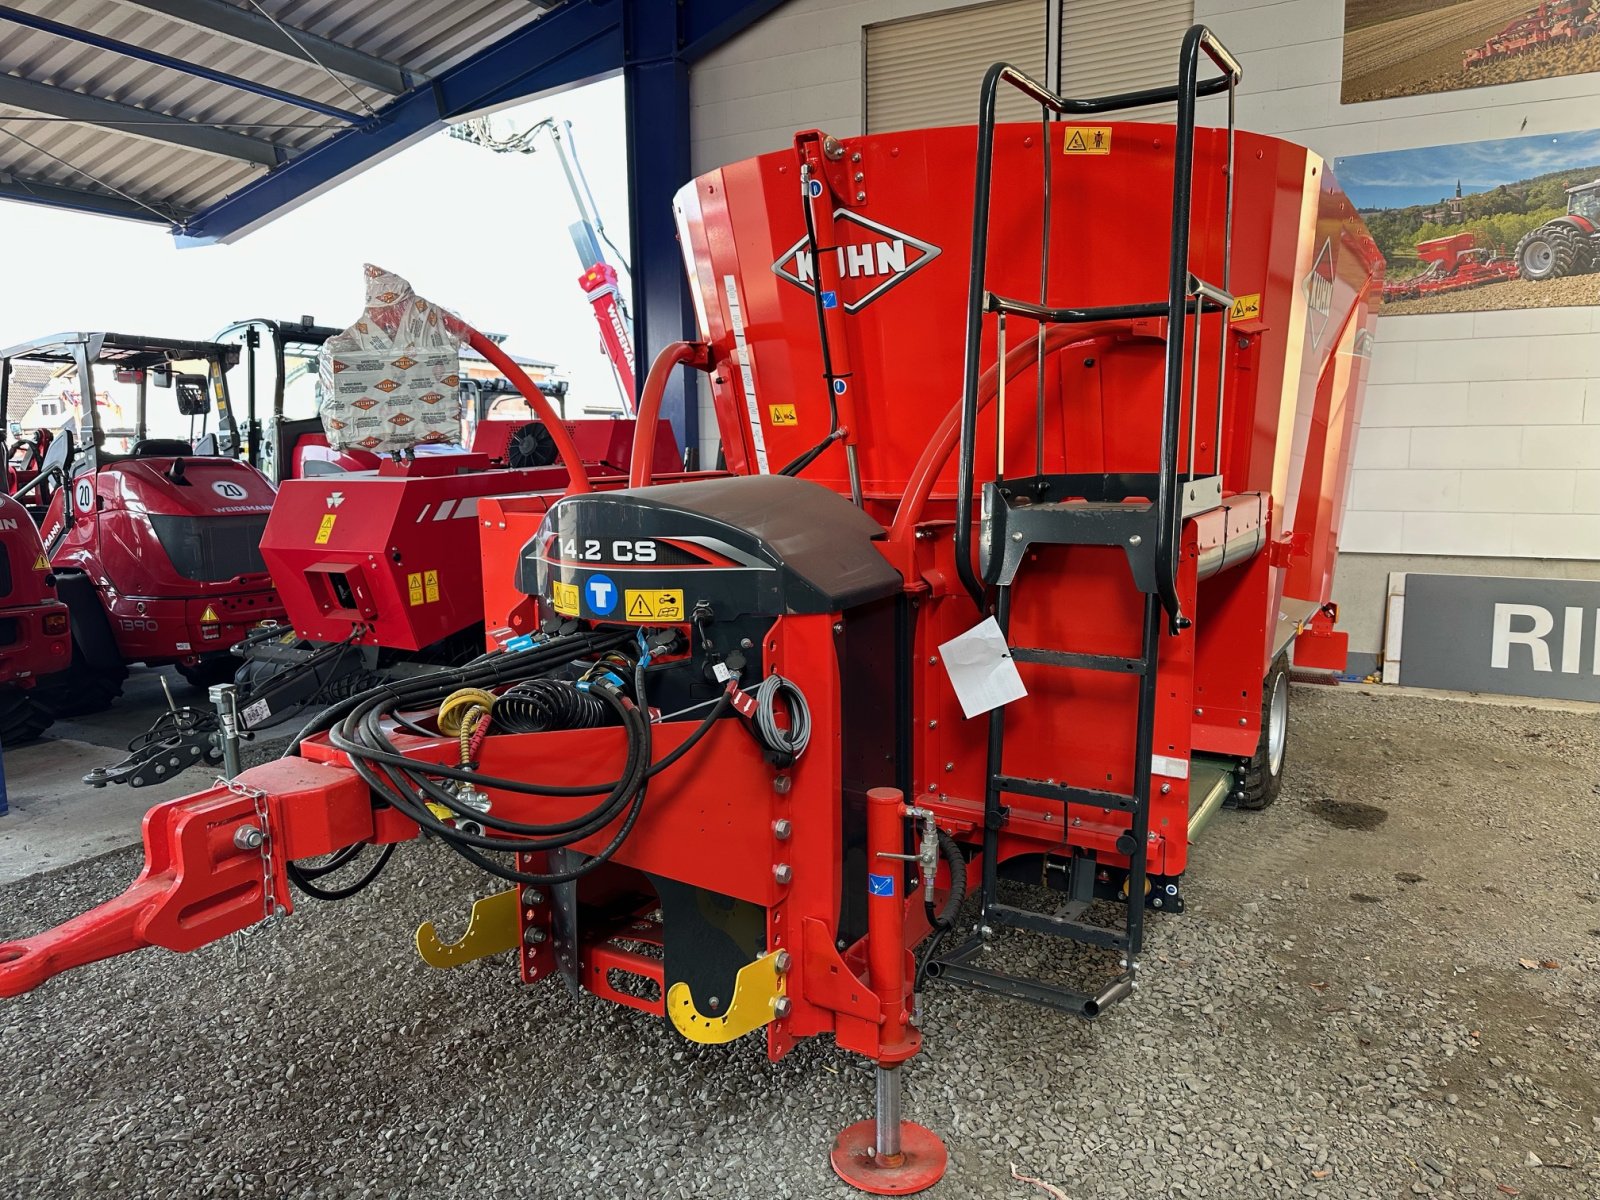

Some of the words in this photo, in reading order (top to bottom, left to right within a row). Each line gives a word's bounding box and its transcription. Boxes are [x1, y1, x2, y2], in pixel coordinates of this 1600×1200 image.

[79, 485, 90, 507] 20
[217, 484, 243, 496] 20
[558, 538, 601, 561] 14.2
[612, 540, 657, 562] CS
[590, 582, 612, 608] T
[1490, 602, 1600, 676] RI
